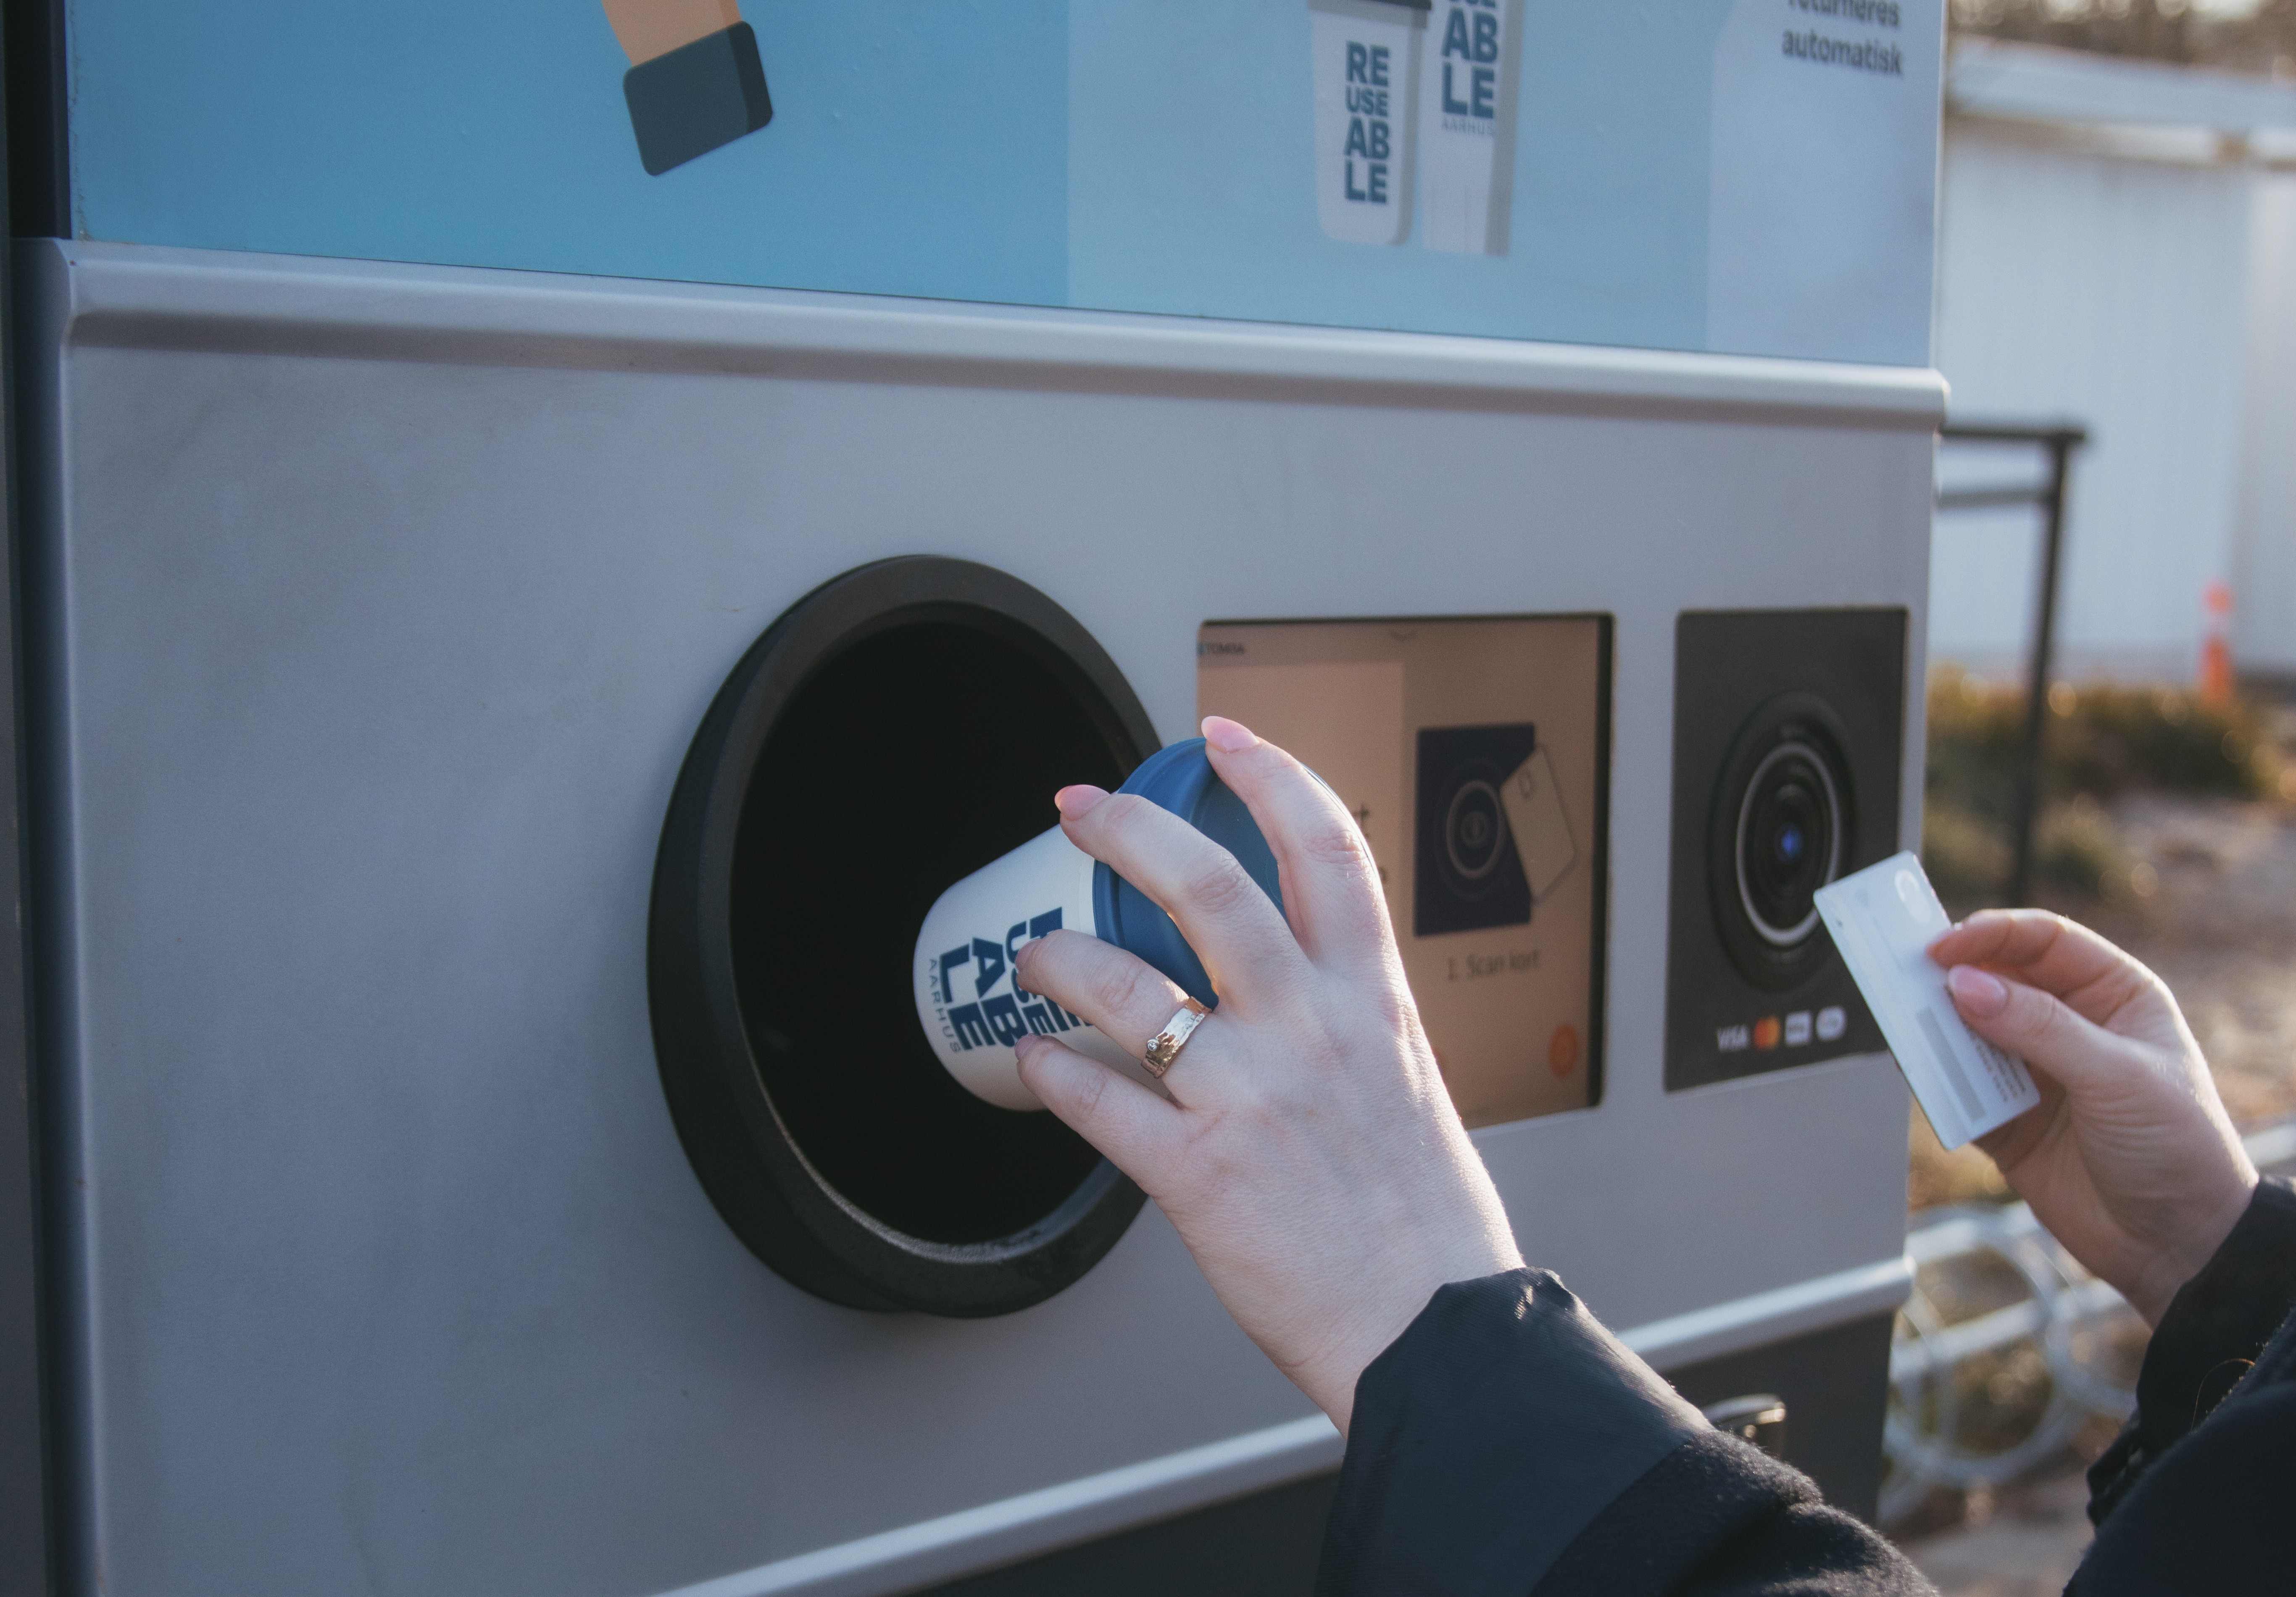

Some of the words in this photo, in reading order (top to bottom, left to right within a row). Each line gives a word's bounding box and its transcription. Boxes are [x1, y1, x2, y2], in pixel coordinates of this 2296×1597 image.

[1442, 8, 1498, 63] AB
[1782, 29, 1902, 74] automatisk
[1346, 41, 1389, 86] RE
[1345, 86, 1389, 116] USE
[1442, 62, 1495, 119] LE
[1345, 116, 1389, 159] AB
[1441, 119, 1494, 135] AARHUS
[1345, 160, 1387, 203] LE
[929, 958, 961, 1053] AARHUS
[940, 944, 996, 1051] LE
[972, 938, 1029, 1048] AB
